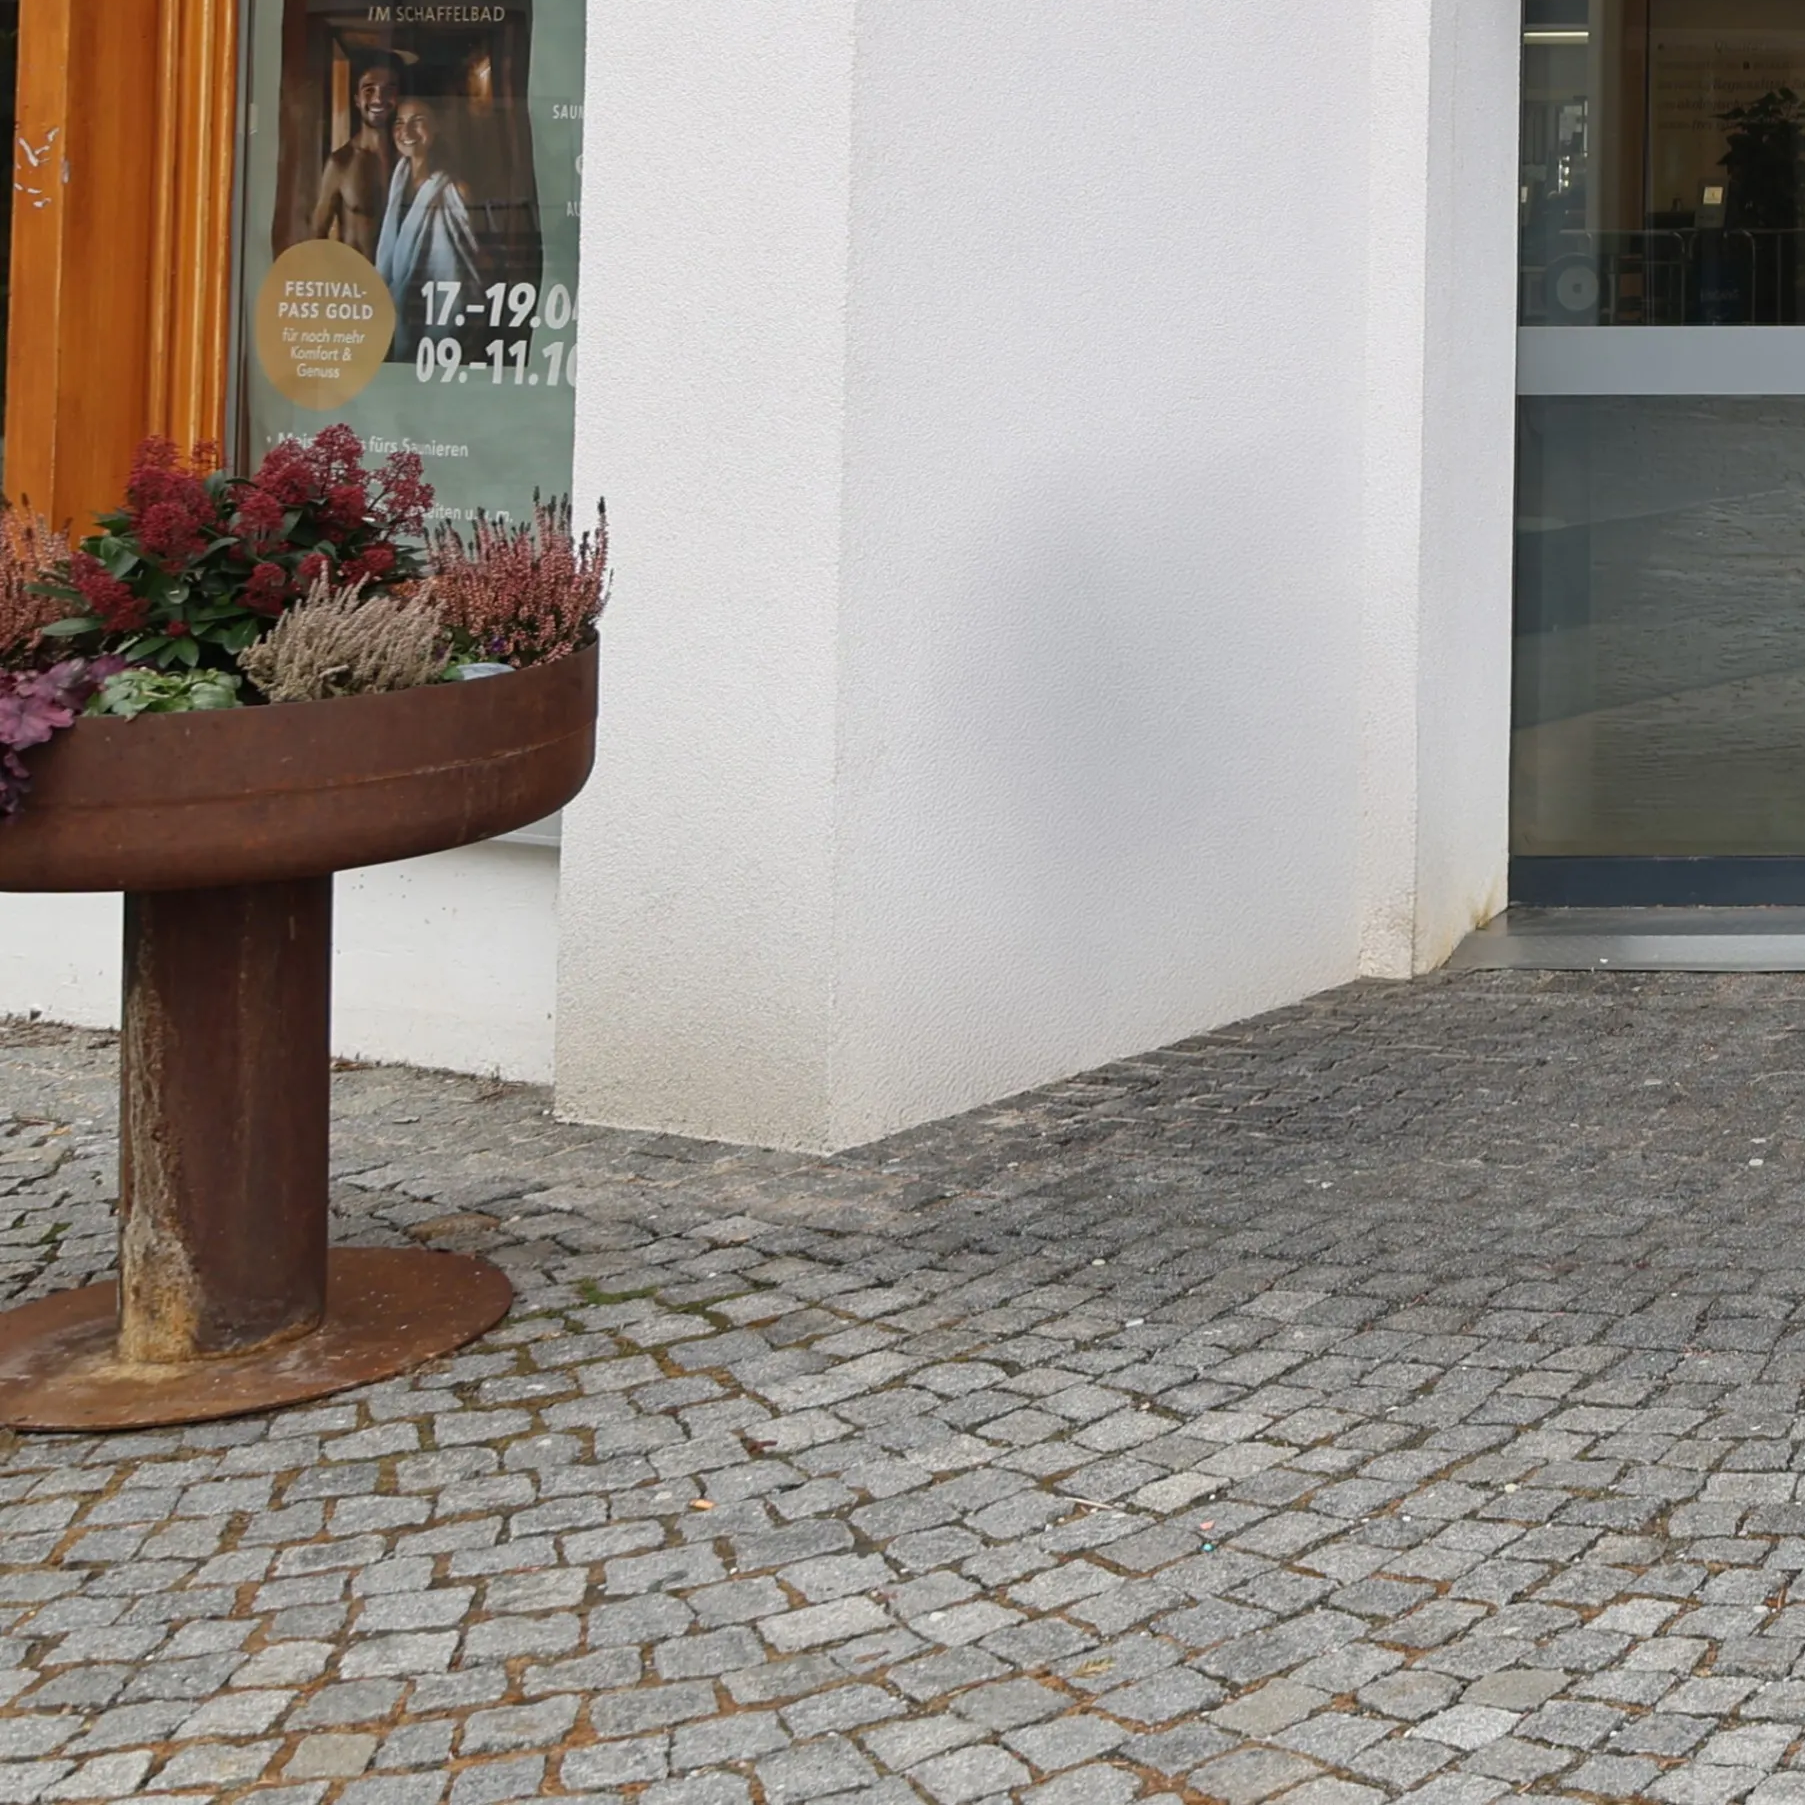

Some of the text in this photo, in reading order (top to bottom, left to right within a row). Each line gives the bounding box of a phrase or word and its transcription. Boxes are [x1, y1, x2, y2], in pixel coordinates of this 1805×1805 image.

[368, 6, 506, 23] IM SCHAFFELBAD
[285, 281, 368, 299] FESTIVAL-
[277, 302, 374, 321] PASS GOLD
[282, 327, 366, 345] für noch mehr
[290, 346, 353, 362] Komfort &
[296, 362, 341, 379] Genuss
[368, 435, 398, 454] fürs
